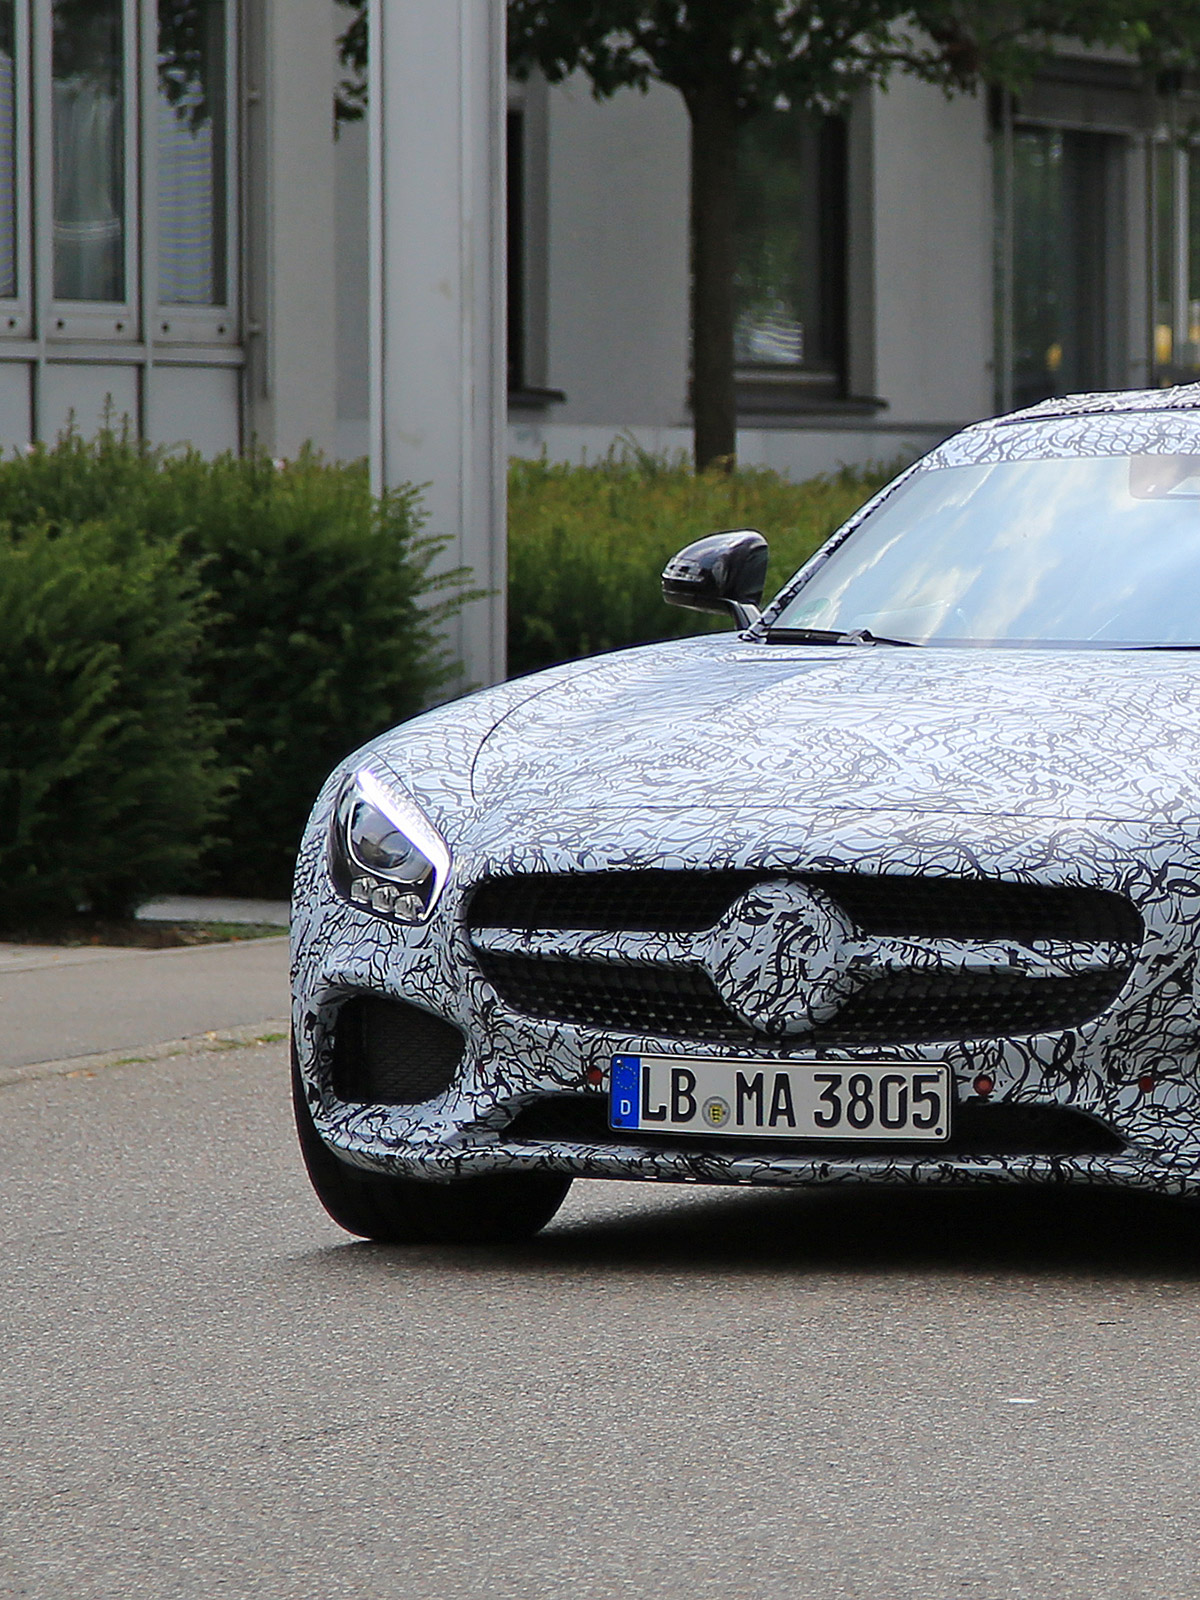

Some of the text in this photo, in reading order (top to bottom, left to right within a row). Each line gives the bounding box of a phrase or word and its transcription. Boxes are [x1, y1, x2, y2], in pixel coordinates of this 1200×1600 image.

[620, 1099, 632, 1116] D
[642, 1066, 941, 1130] LB MA 3805
